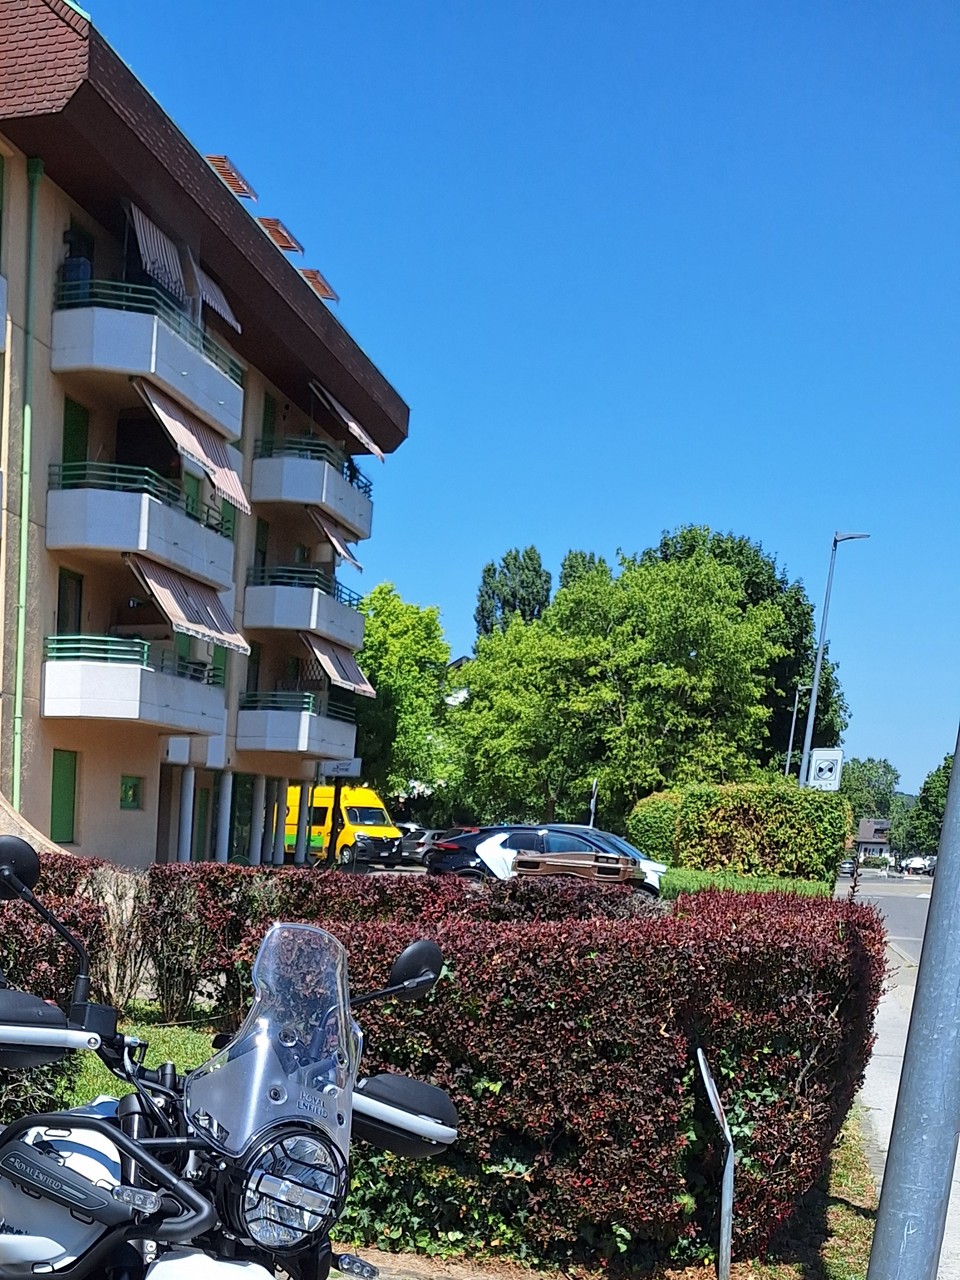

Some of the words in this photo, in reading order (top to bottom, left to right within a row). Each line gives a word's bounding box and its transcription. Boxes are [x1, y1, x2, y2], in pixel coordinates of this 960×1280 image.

[300, 1090, 326, 1108] ROYAL
[297, 1100, 329, 1119] ENFIELD
[13, 1158, 35, 1176] ROYAL
[33, 1169, 62, 1190] ENFIELD
